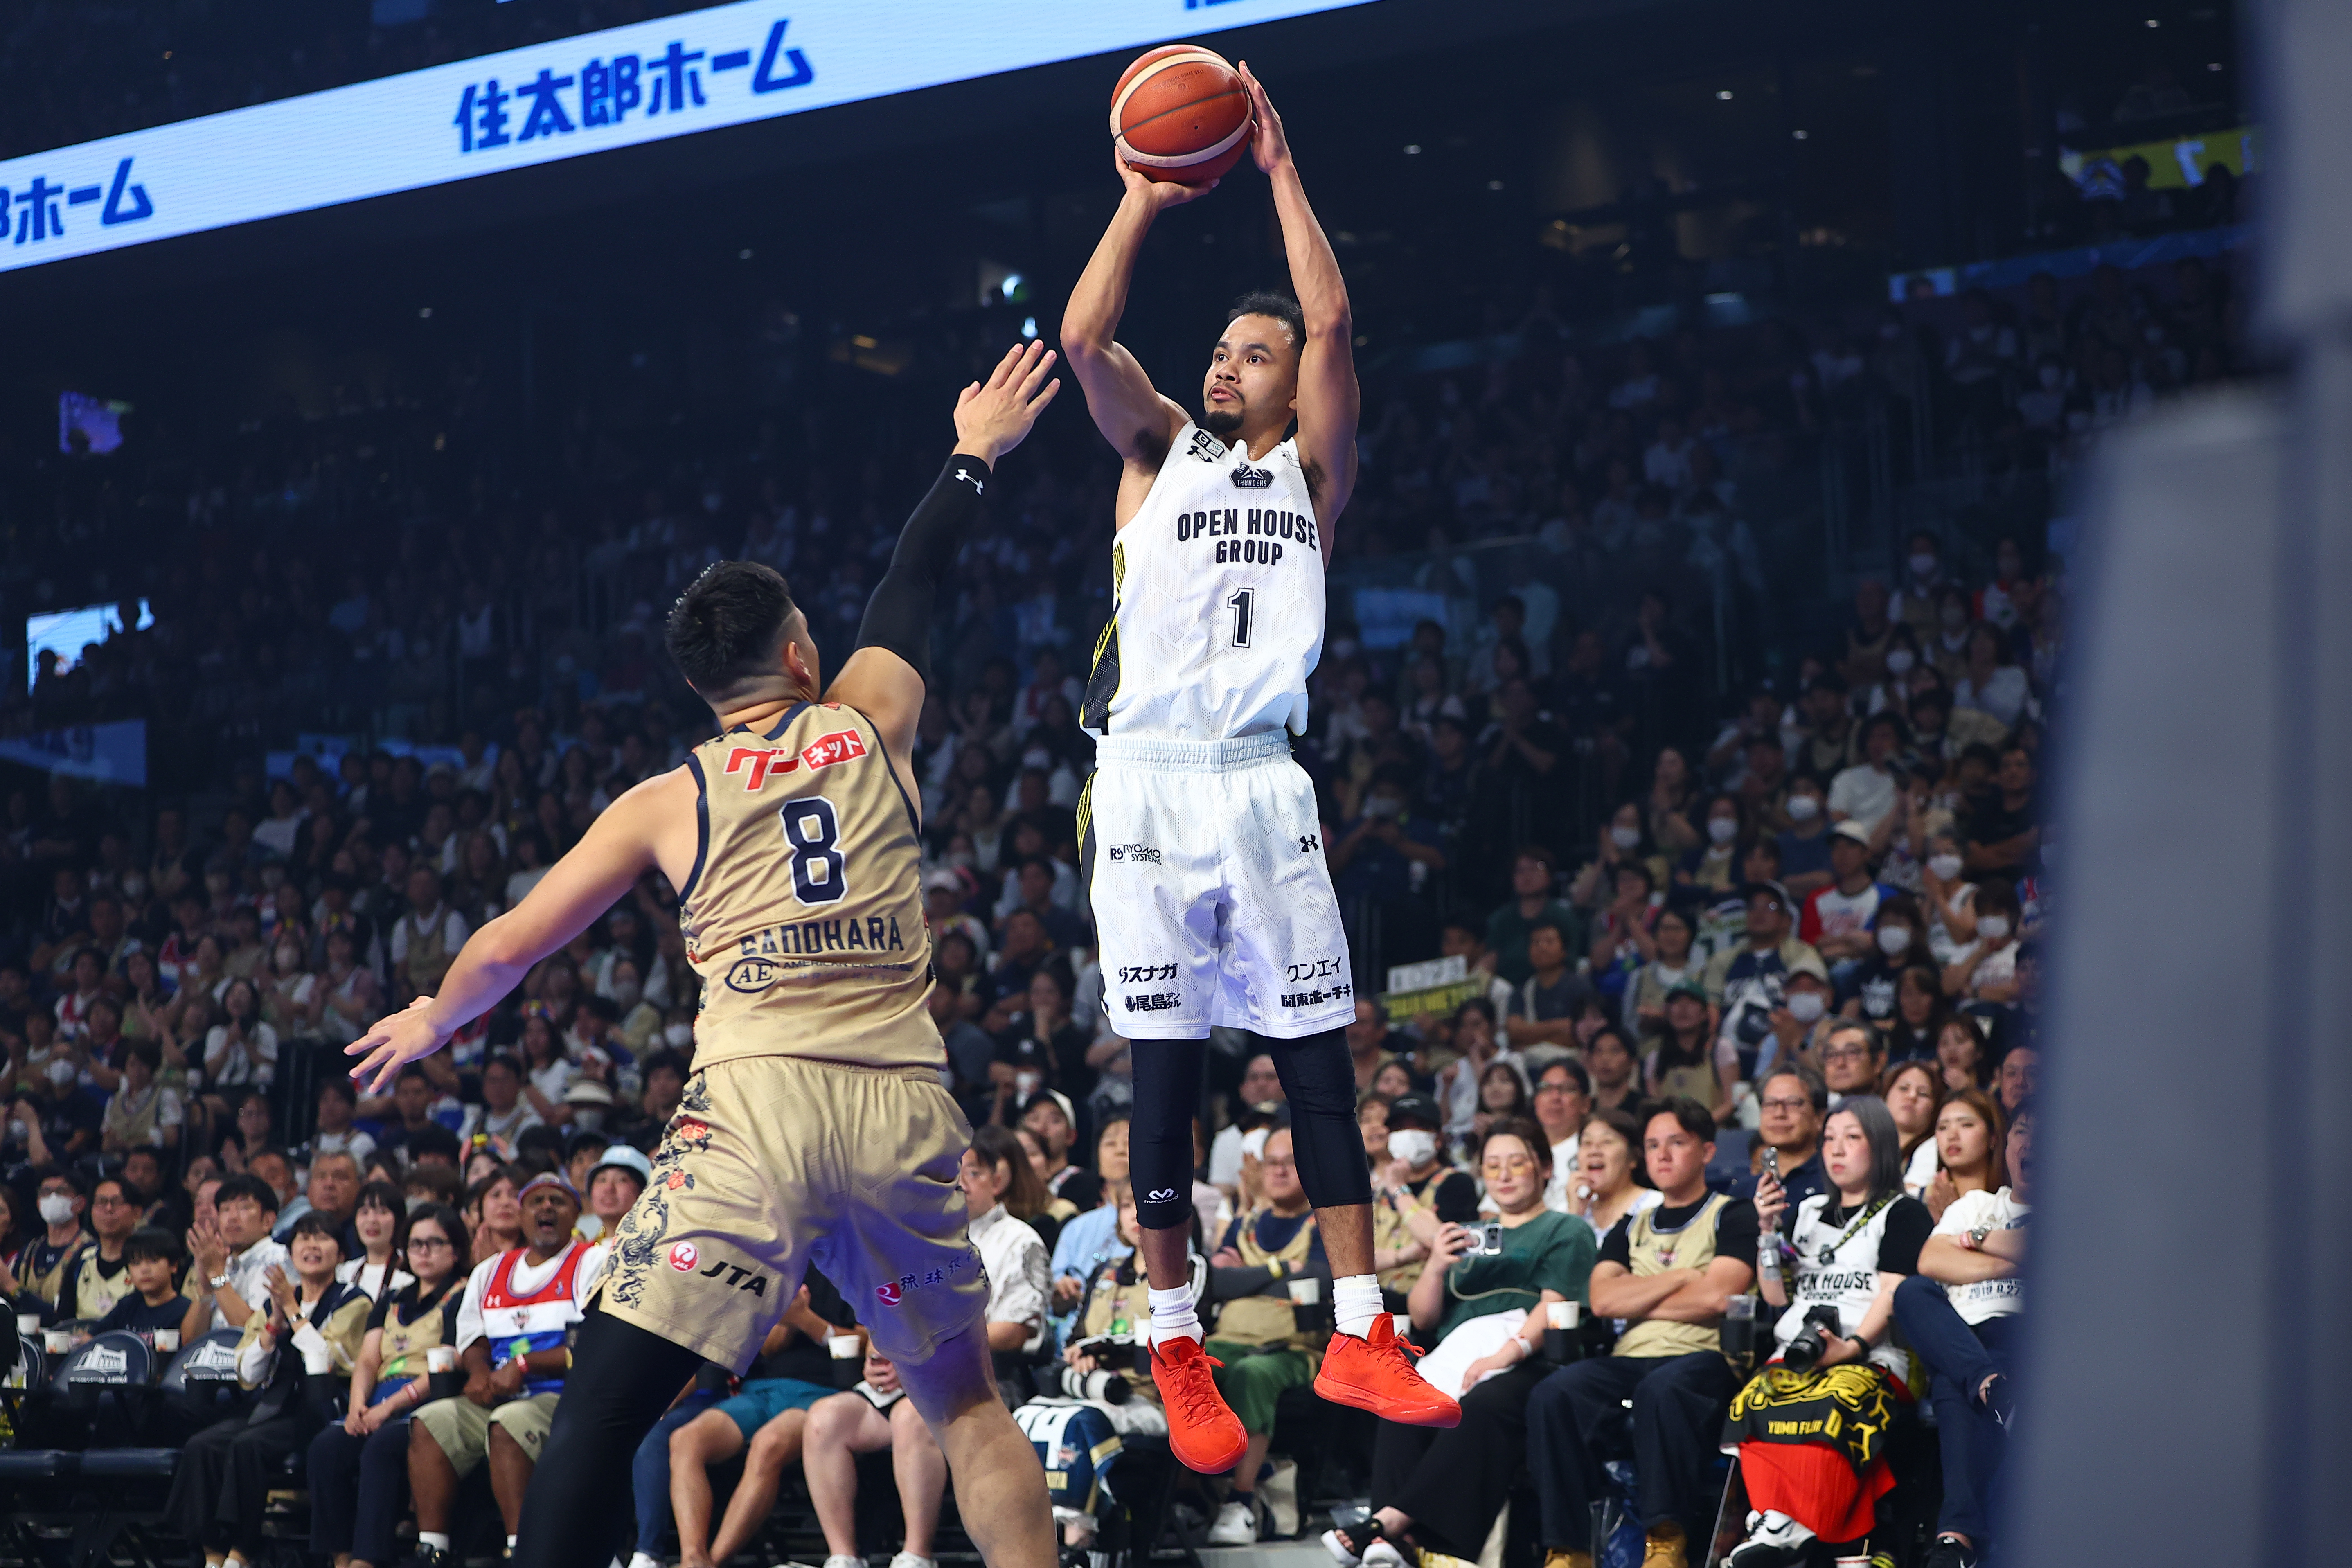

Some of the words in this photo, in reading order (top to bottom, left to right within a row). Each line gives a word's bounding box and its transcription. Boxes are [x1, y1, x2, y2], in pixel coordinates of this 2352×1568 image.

[454, 19, 813, 153] 住太郎ホーム
[1177, 509, 1238, 541] OPEN
[1247, 509, 1316, 552] HOUSE
[1216, 539, 1282, 566] GROUP
[1227, 587, 1254, 648] 1
[778, 795, 849, 907] 8
[1124, 844, 1161, 858] RYOMO
[1131, 853, 1162, 865] SYSTEMS
[736, 963, 774, 984] AE
[1129, 963, 1178, 983] スナガ
[1287, 956, 1341, 982] グンエイ
[1281, 983, 1351, 1008] 関東ホーチキ
[699, 1261, 767, 1297] JTA
[1822, 1271, 1872, 1291] HOUSE
